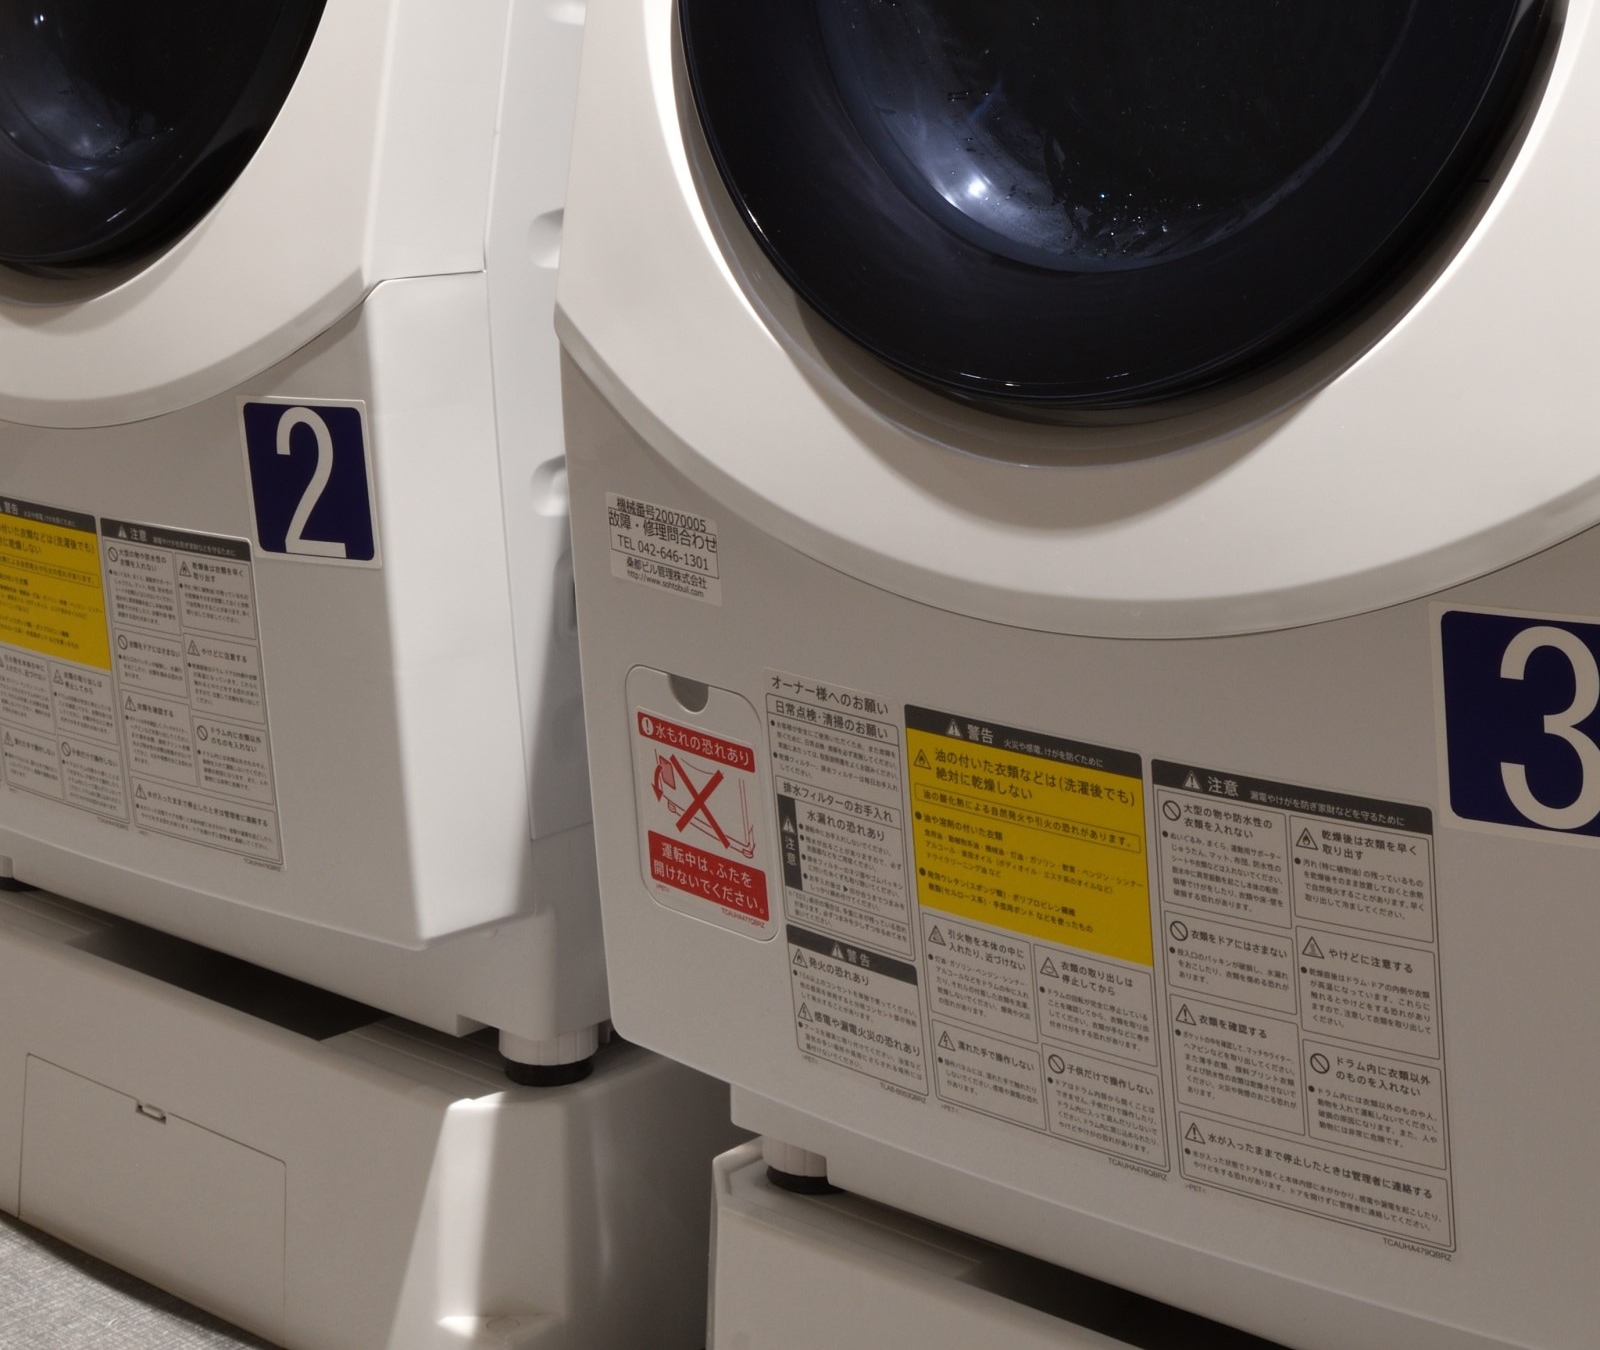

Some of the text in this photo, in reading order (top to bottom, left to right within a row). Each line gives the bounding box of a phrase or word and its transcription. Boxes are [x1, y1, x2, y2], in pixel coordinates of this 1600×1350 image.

[276, 407, 347, 558] 2
[616, 497, 707, 533] 機械番号20070005
[609, 511, 717, 554] 故障・修理問合わせ
[617, 535, 709, 571] TEL 042-646-1301
[626, 556, 708, 590] 桑都ビル管理株式会社
[772, 676, 889, 715] オーナー様へのお願い
[775, 700, 888, 738] 日常点検・清掃のお願い
[967, 724, 994, 744] 警告
[655, 724, 749, 767] 水もれの恐れあり
[936, 767, 1033, 799] 絶対に乾燥しない
[1207, 775, 1239, 797] 注意
[783, 782, 893, 824] 排水フィルターのお手入れ
[1183, 803, 1273, 829] 大型の物や防水性の
[806, 810, 885, 842] 水漏れの恐れあり
[1184, 818, 1254, 839] 衣類を入れない
[1321, 829, 1417, 855] 乾燥後は衣類を早く
[662, 843, 752, 888] 運転中は、ふたを
[1322, 844, 1364, 861] 取り出す
[653, 860, 766, 916] 開けないでください。
[947, 929, 1025, 959] 引火物を本体の中に
[948, 942, 1026, 972] 入れたり、近づけない
[1191, 930, 1288, 959] 衣類をドアにはさまない
[808, 956, 871, 987] 発火の恐れあり
[1060, 959, 1134, 989] 衣類の取り出しは
[1329, 947, 1413, 974] やけどに注意する
[1061, 973, 1116, 997] 停止してから
[813, 1011, 921, 1057] 感電や漏電火災の恐れあり
[1199, 1014, 1268, 1040] 衣類を確認する
[957, 1040, 1035, 1072] 濡れた手で操作しない
[1336, 1056, 1431, 1086] ドラム内に衣類以外
[1066, 1062, 1153, 1096] 子供だけで操作しない
[1335, 1070, 1421, 1097] のものを入れない
[1207, 1133, 1433, 1199] 水が入ったままで停止したときは管理者に連絡する
